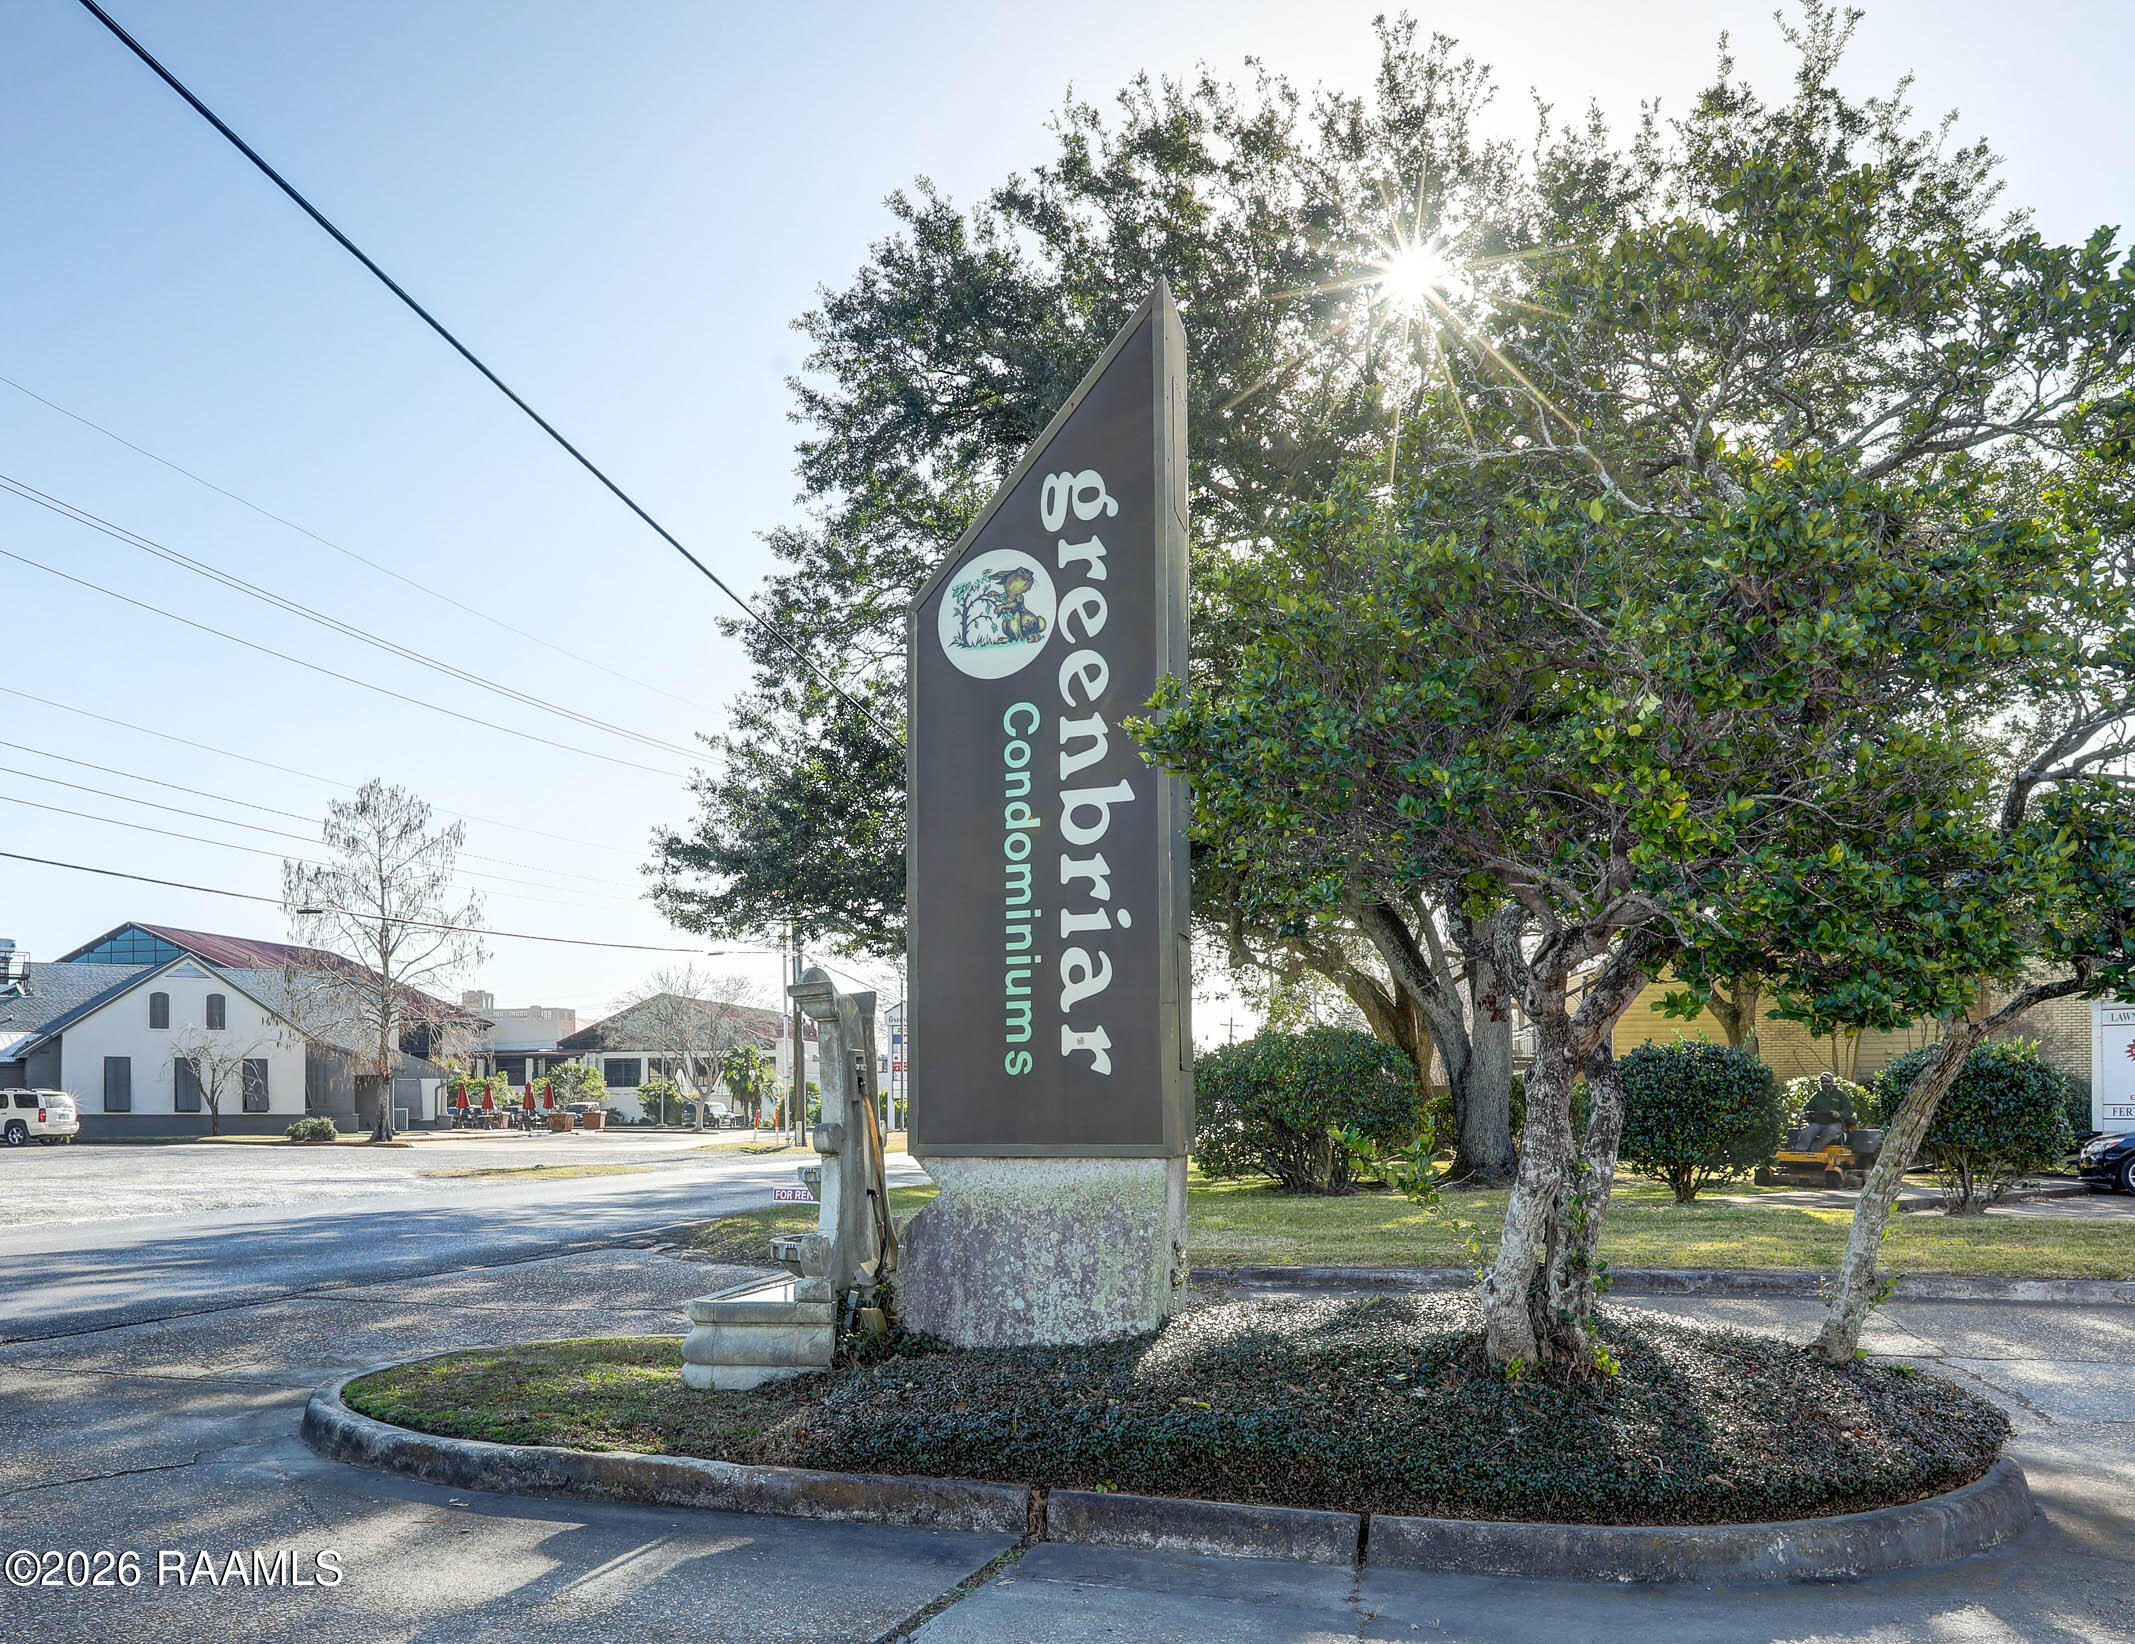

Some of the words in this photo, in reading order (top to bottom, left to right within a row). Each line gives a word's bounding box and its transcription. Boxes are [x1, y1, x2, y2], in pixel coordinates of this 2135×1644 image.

[1041, 469, 1135, 1076] greenbriar
[1003, 701, 1042, 1076] Condominiums
[775, 1189, 793, 1201] FOR
[794, 1189, 814, 1201] REN
[2112, 1106, 2135, 1117] FER
